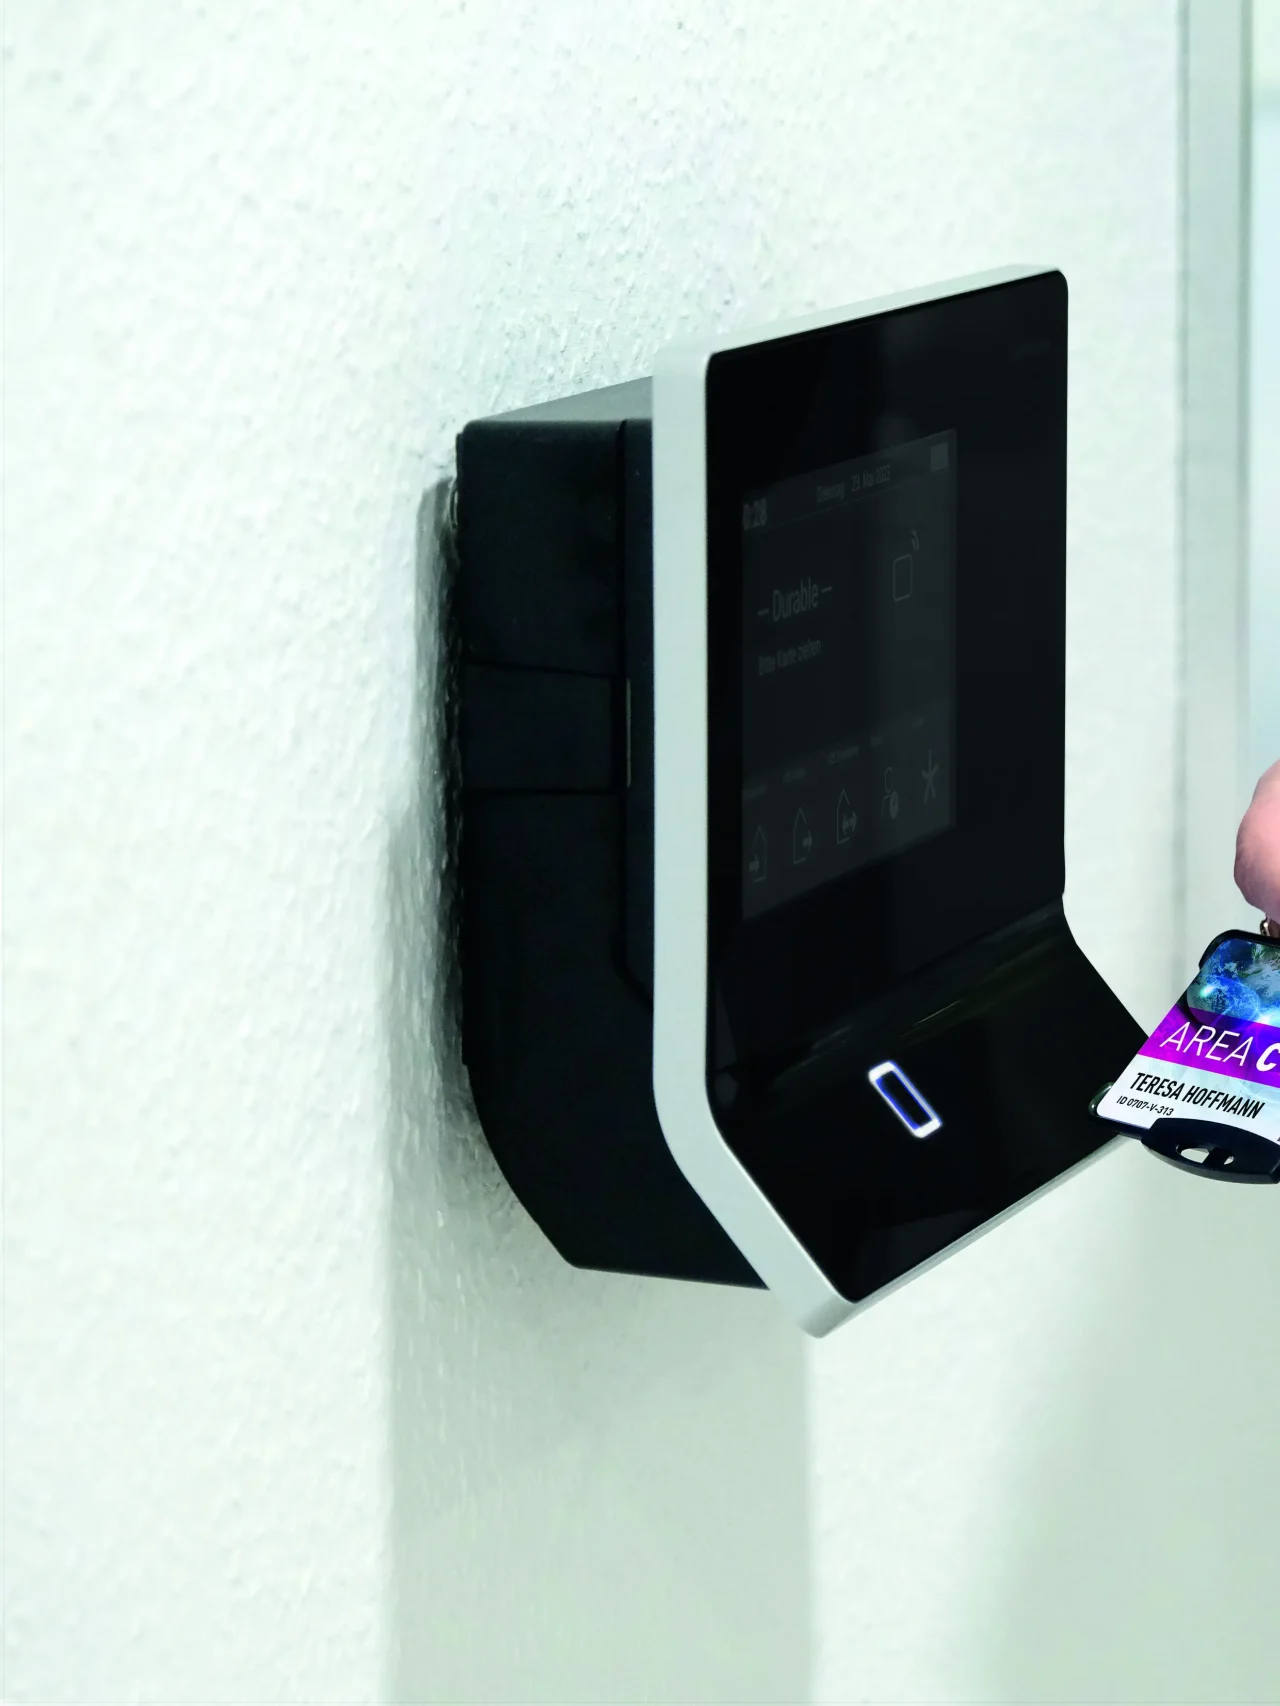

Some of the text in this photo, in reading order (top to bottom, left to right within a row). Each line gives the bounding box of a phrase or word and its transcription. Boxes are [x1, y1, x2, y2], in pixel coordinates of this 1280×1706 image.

[772, 575, 819, 621] Durable
[1159, 1021, 1254, 1067] AREA
[1116, 1095, 1175, 1117] ID 0707-V-313
[1129, 1072, 1266, 1119] TERESA HOFFMANN
